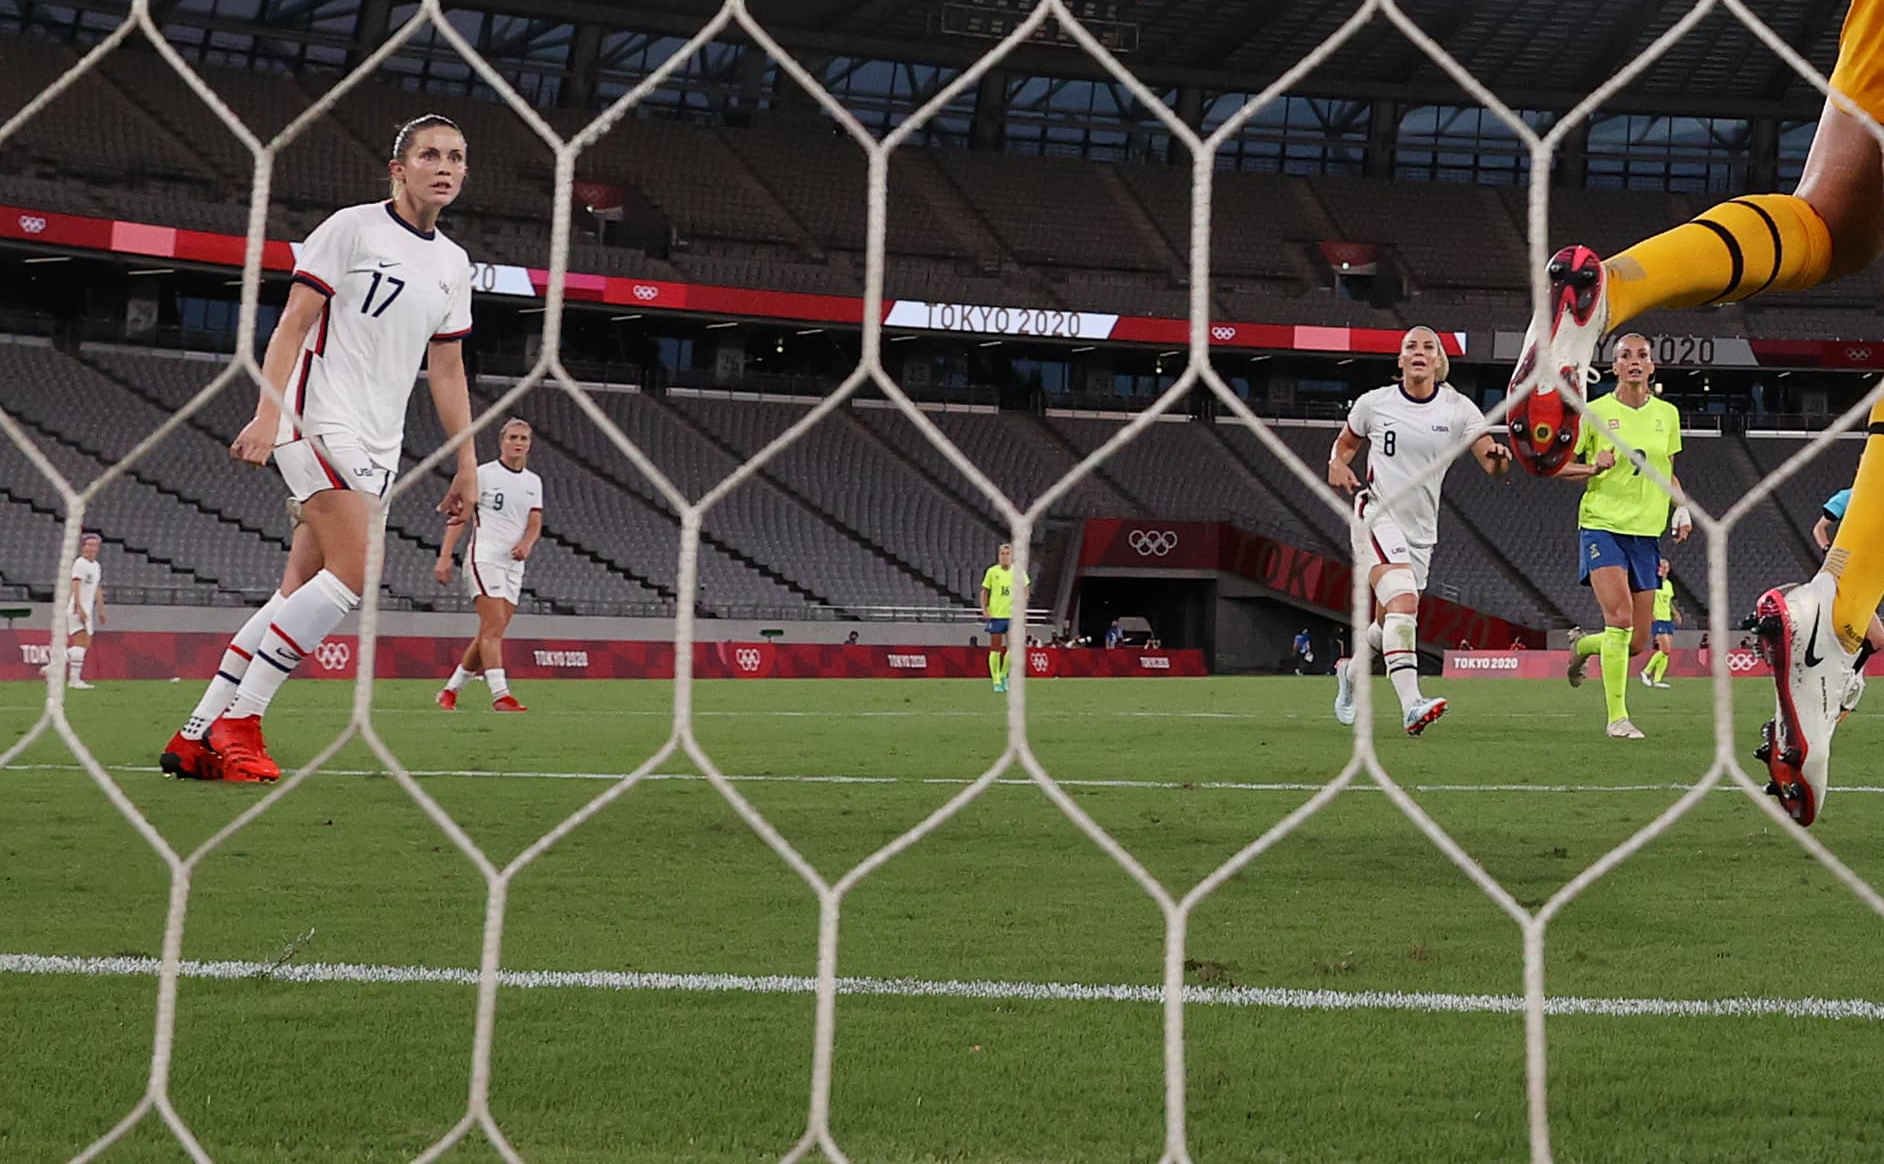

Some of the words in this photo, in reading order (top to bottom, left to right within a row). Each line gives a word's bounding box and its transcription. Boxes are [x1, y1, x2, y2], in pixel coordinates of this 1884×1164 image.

[360, 271, 405, 318] 17
[925, 302, 1009, 333] TOKYO
[1018, 308, 1080, 337] 2020
[1384, 430, 1396, 457] 8
[492, 492, 504, 511] 9
[1001, 586, 1010, 596] 16
[1453, 657, 1490, 669] TOKYO
[1491, 657, 1518, 669] 2020
